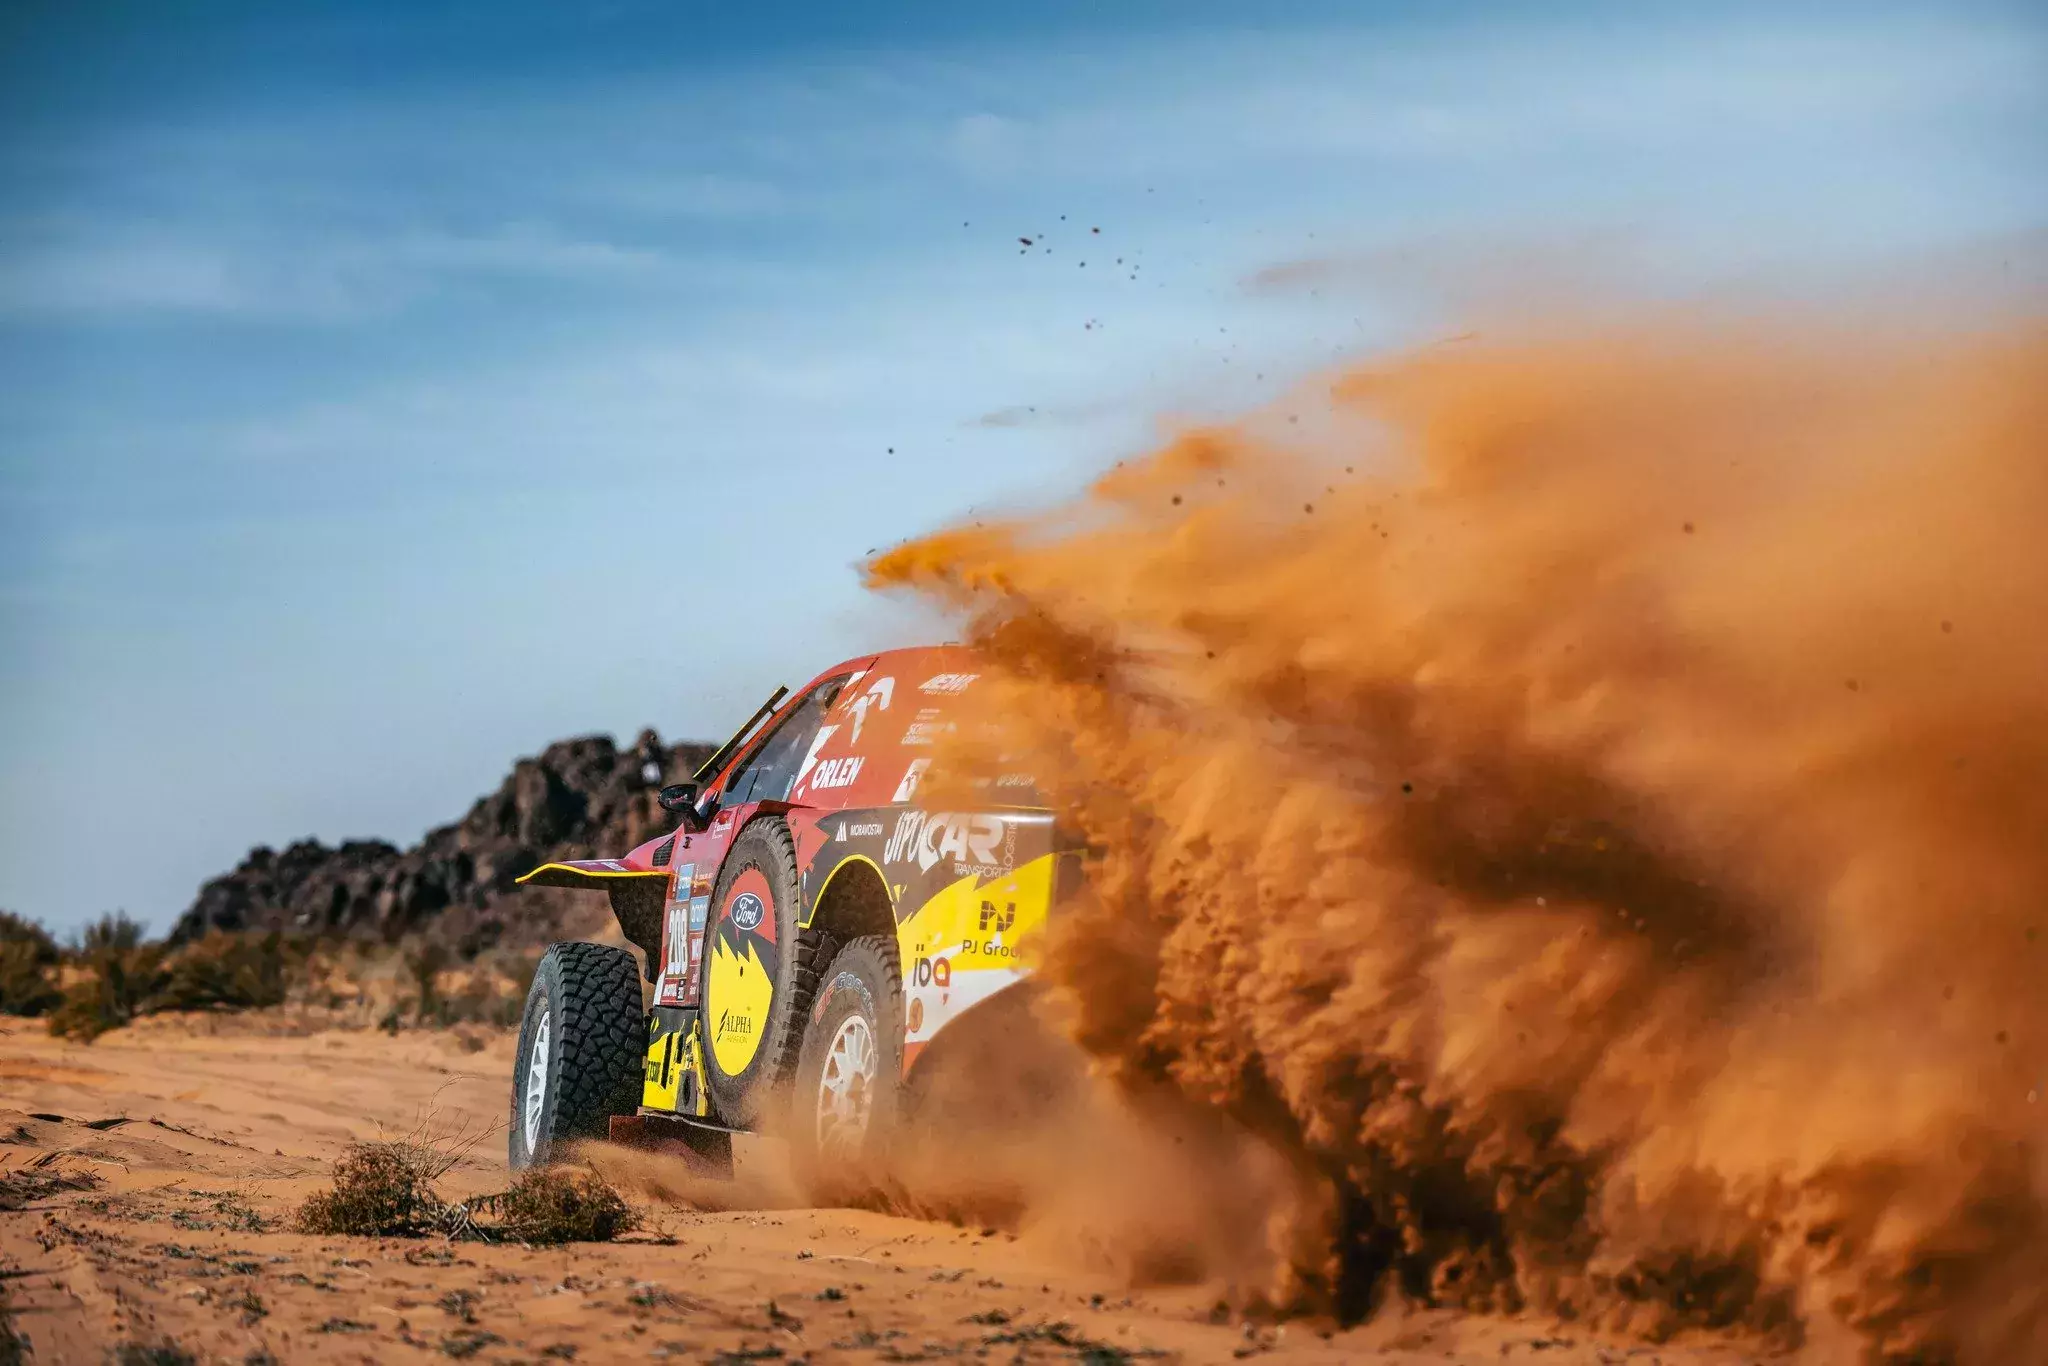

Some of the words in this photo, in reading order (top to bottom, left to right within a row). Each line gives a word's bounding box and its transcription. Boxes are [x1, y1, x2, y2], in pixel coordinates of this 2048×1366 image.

[812, 756, 865, 789] ORLEN
[883, 810, 1004, 876] JIPOCAR
[735, 896, 759, 925] Ford
[667, 908, 688, 975] 208
[962, 939, 978, 954] PJ
[725, 1015, 752, 1034] ALPHA
